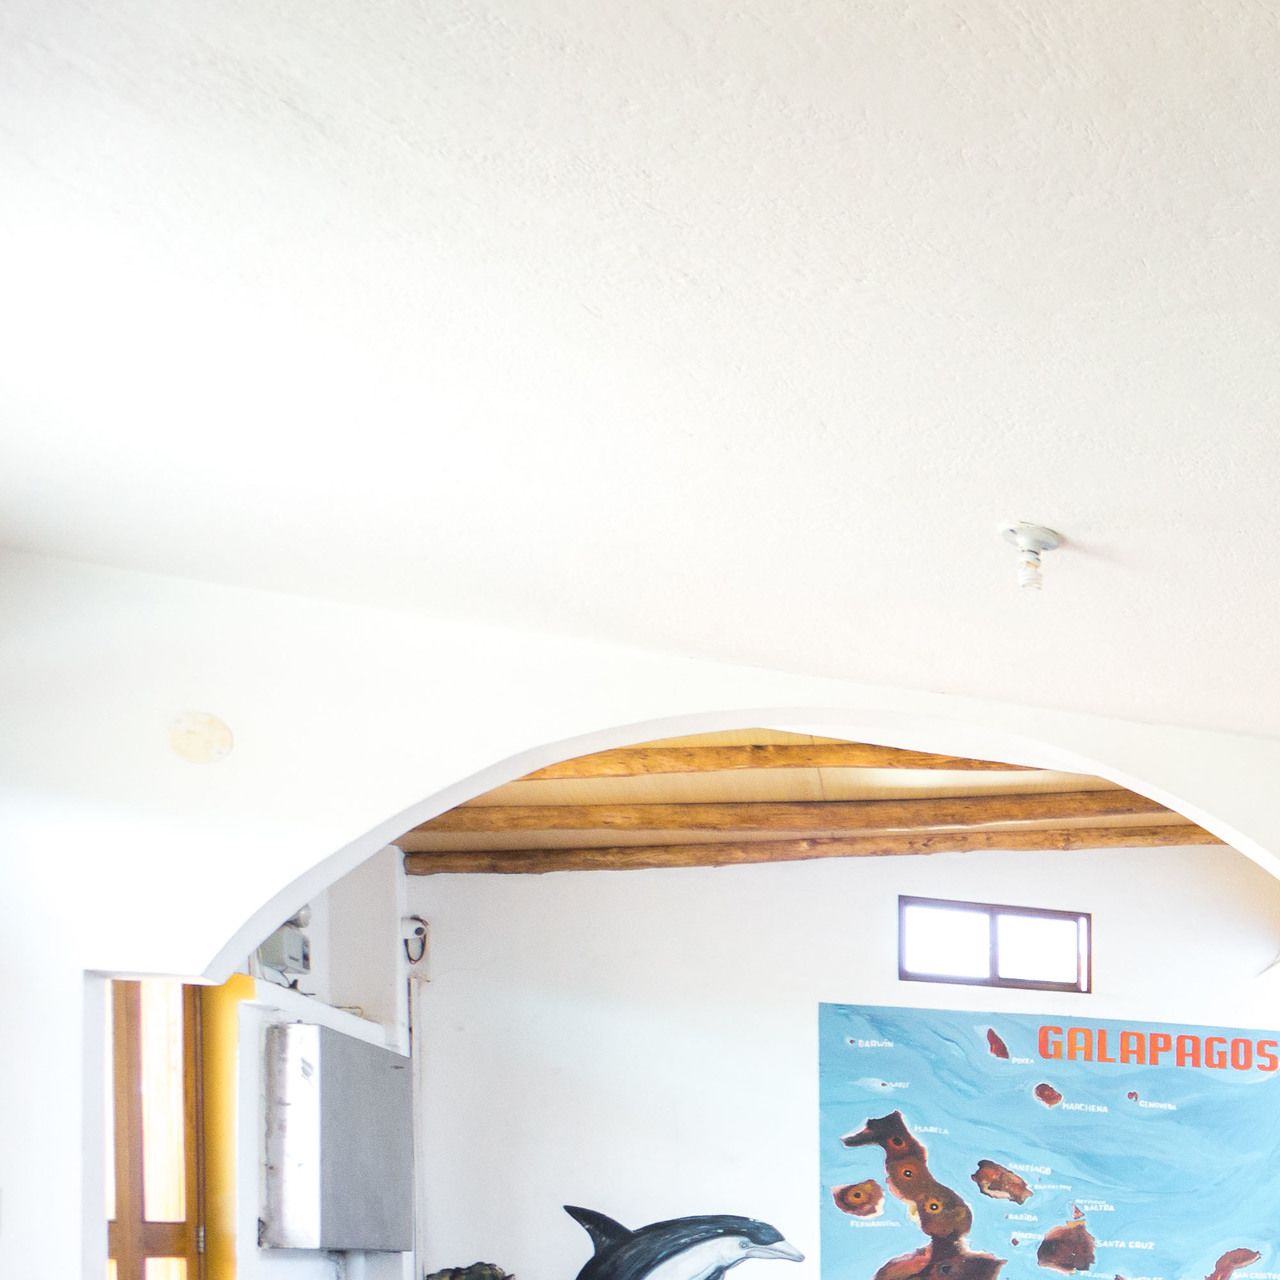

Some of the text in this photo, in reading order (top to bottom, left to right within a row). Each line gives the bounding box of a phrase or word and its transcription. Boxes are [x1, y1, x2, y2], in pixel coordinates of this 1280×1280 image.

[1037, 1025, 1279, 1073] GALAPAGOS
[1062, 1101, 1109, 1114] MARCHENA
[1096, 1239, 1155, 1250] SANTA CRUZ
